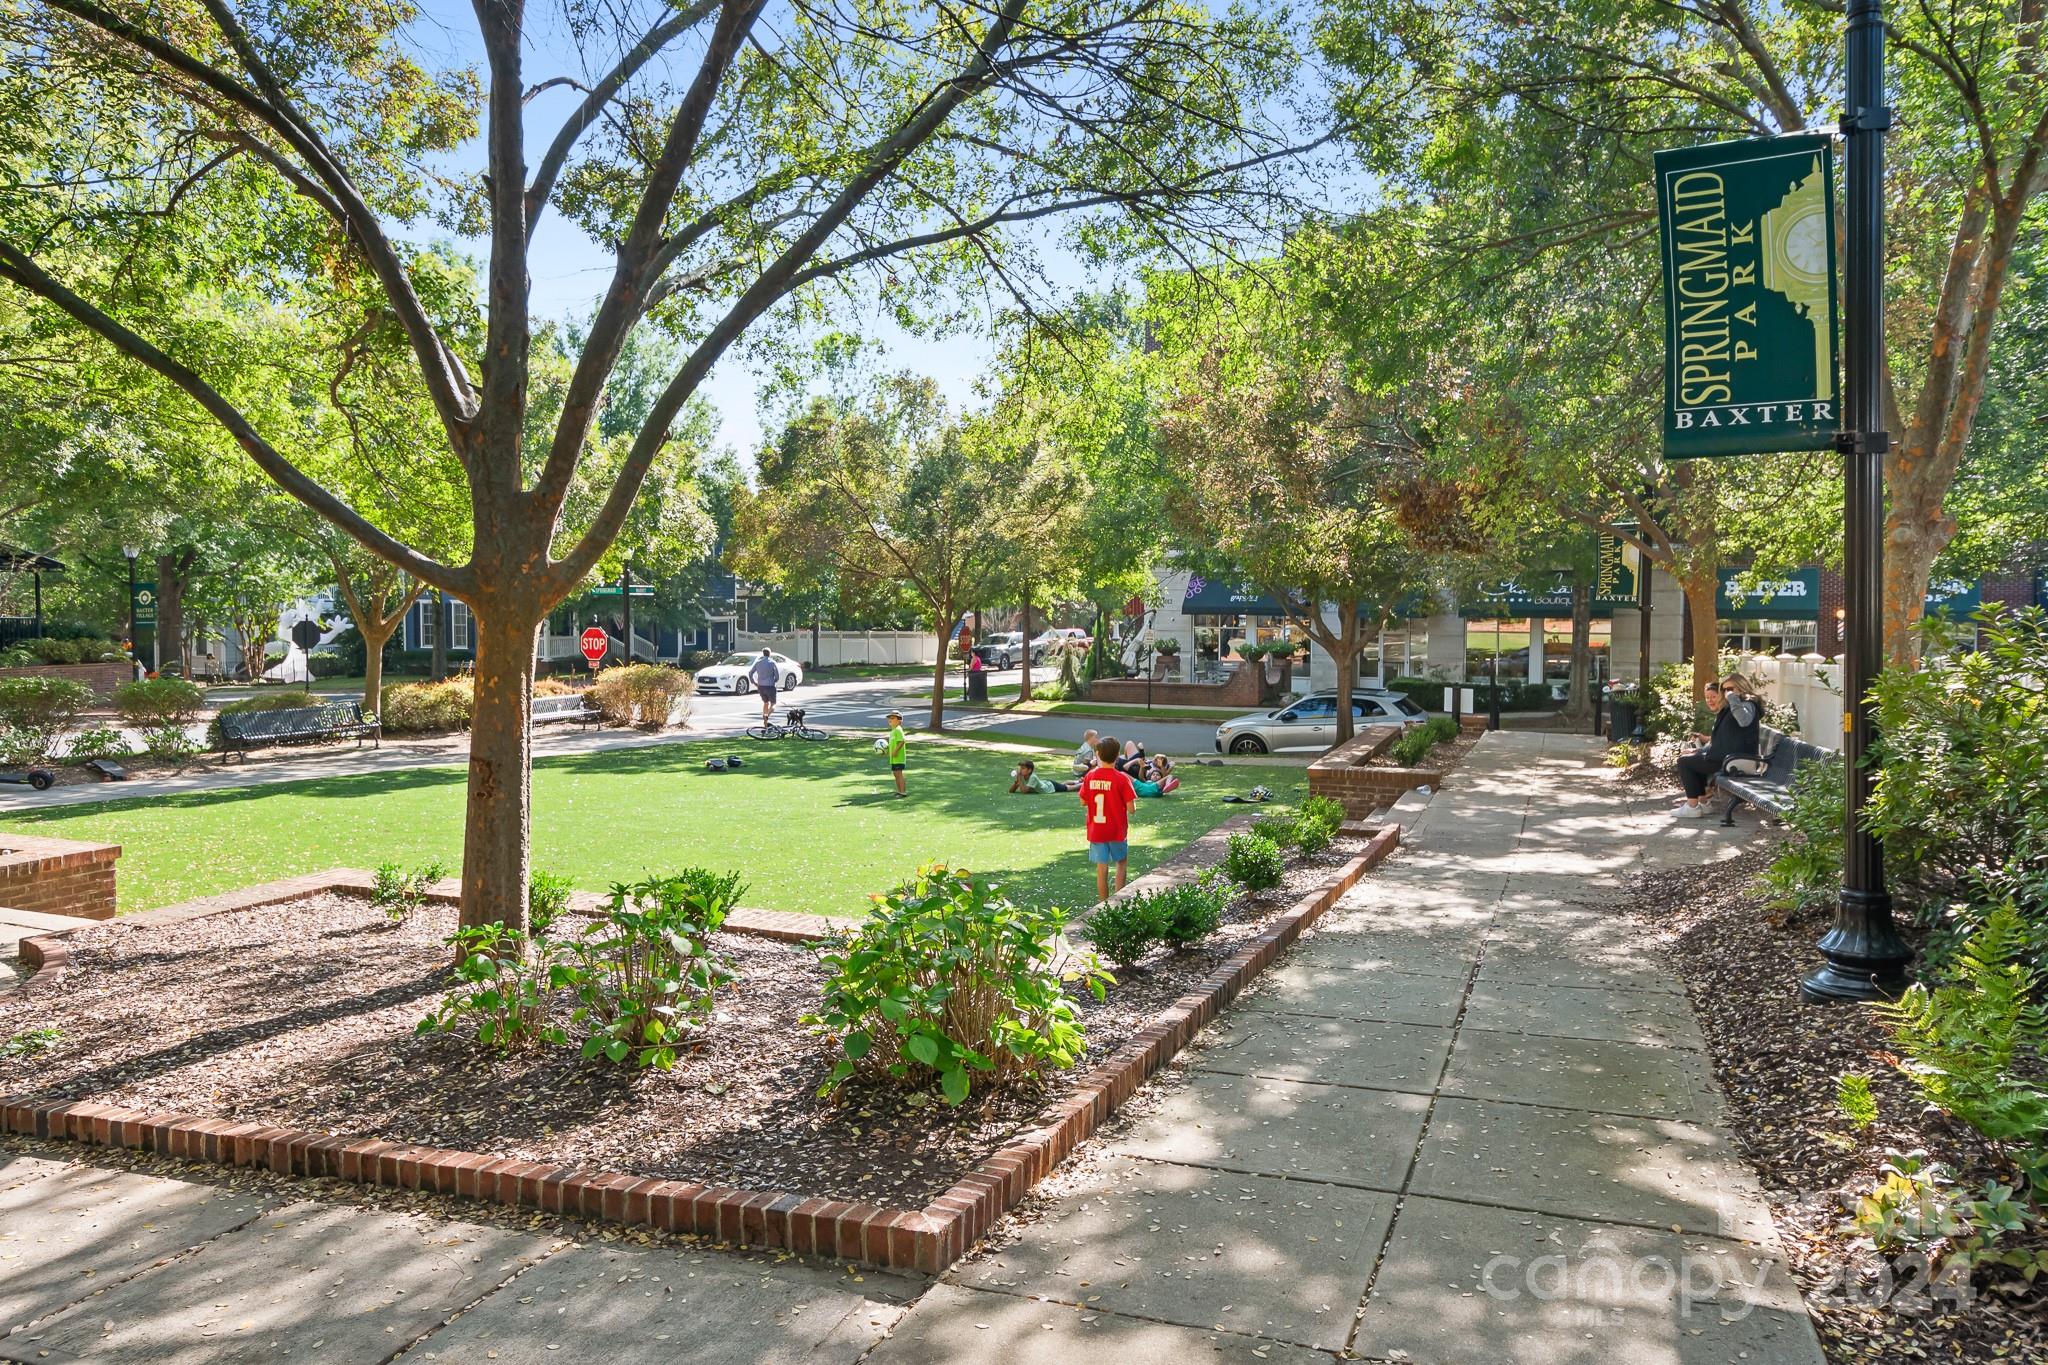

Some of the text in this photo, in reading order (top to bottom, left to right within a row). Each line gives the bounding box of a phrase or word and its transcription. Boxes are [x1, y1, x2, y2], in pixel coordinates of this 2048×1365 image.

[1674, 172, 1731, 405] SPRINGMAID
[1731, 219, 1757, 362] PARK
[1675, 403, 1835, 430] BAXTER
[1534, 595, 1573, 607] Boutiq
[582, 637, 605, 650] STOP
[1093, 793, 1107, 824] 1
